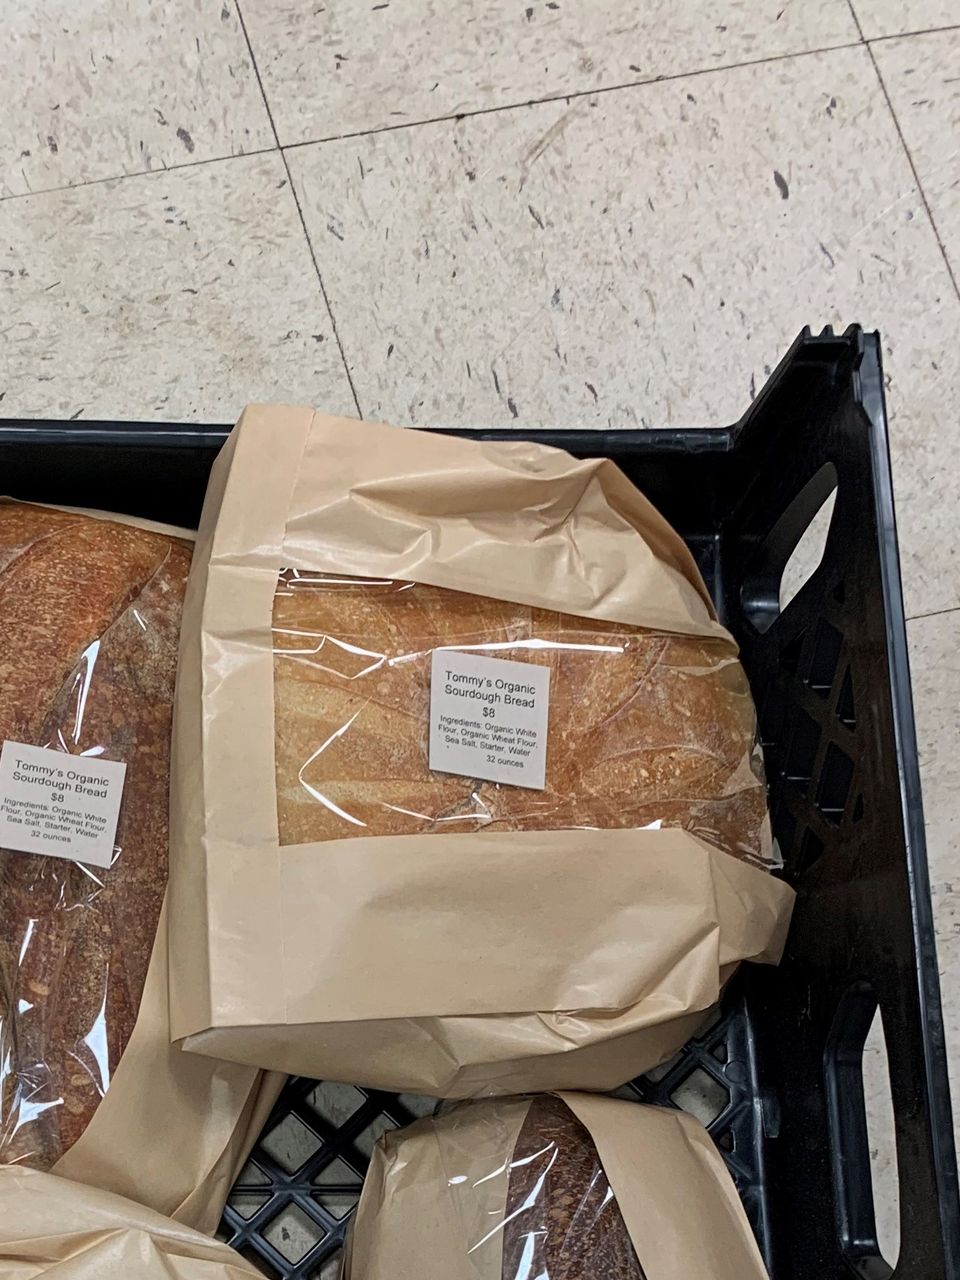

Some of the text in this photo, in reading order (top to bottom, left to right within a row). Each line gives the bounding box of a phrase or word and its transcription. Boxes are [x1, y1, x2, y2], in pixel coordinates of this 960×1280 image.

[445, 671, 535, 694] Tommy's Organic
[445, 684, 534, 708] Sourdough Bread
[482, 707, 495, 718] $8
[461, 729, 489, 740] Organic
[492, 734, 515, 744] Wheat
[485, 723, 513, 734] Organic
[515, 728, 536, 737] White
[445, 735, 459, 744] Sea
[509, 747, 530, 756] Water
[486, 755, 524, 768] 32 ounces
[15, 760, 109, 786] Tommy's Organic
[12, 772, 107, 798] Sourdough Bread
[51, 792, 64, 802] $8
[25, 810, 56, 821] Organic
[58, 816, 84, 826] Wheat
[52, 806, 82, 818] Organic
[84, 812, 107, 824] White
[6, 815, 22, 824] Sea
[75, 828, 98, 838] Water
[42, 834, 71, 842] ounces
